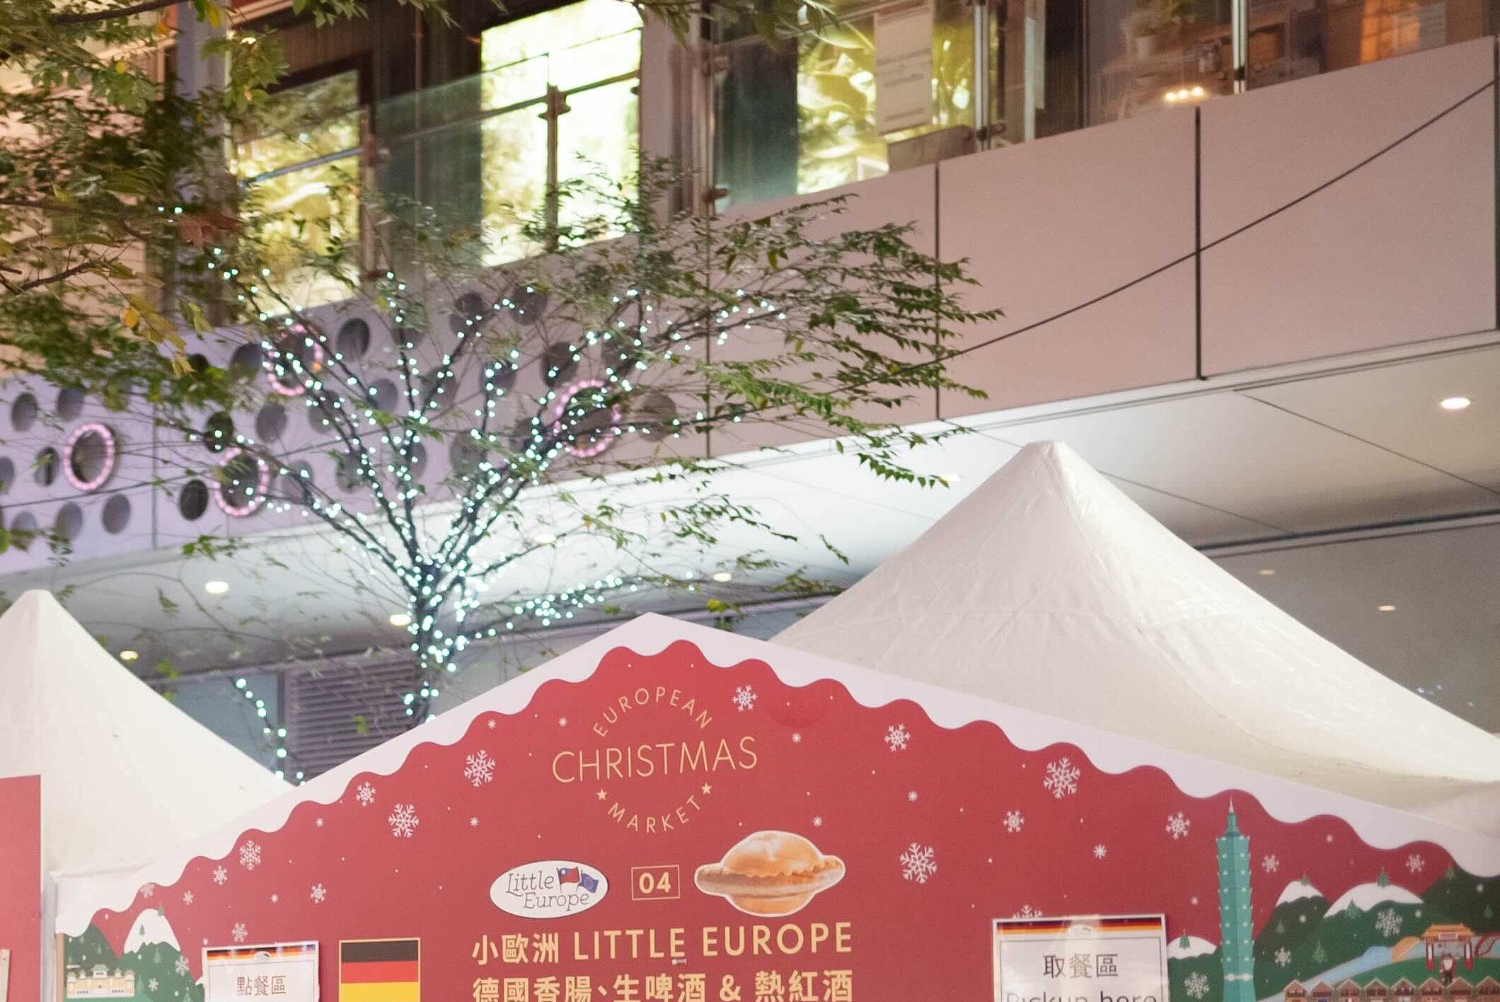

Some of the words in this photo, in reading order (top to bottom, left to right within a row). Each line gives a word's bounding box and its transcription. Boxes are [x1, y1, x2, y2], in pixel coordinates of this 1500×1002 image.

[593, 686, 713, 737] EUROPEAN
[552, 736, 758, 783] CHRISTMAS
[607, 795, 701, 834] MARKET
[506, 870, 555, 897] Little
[638, 872, 672, 894] 04
[523, 892, 590, 912] Europe
[471, 932, 559, 965] 小歐洲
[573, 928, 686, 960] LITTLE
[702, 921, 853, 957] EUROPE
[1043, 953, 1119, 979] 取餐區
[237, 975, 287, 996] 點餐區
[719, 974, 742, 1002] &
